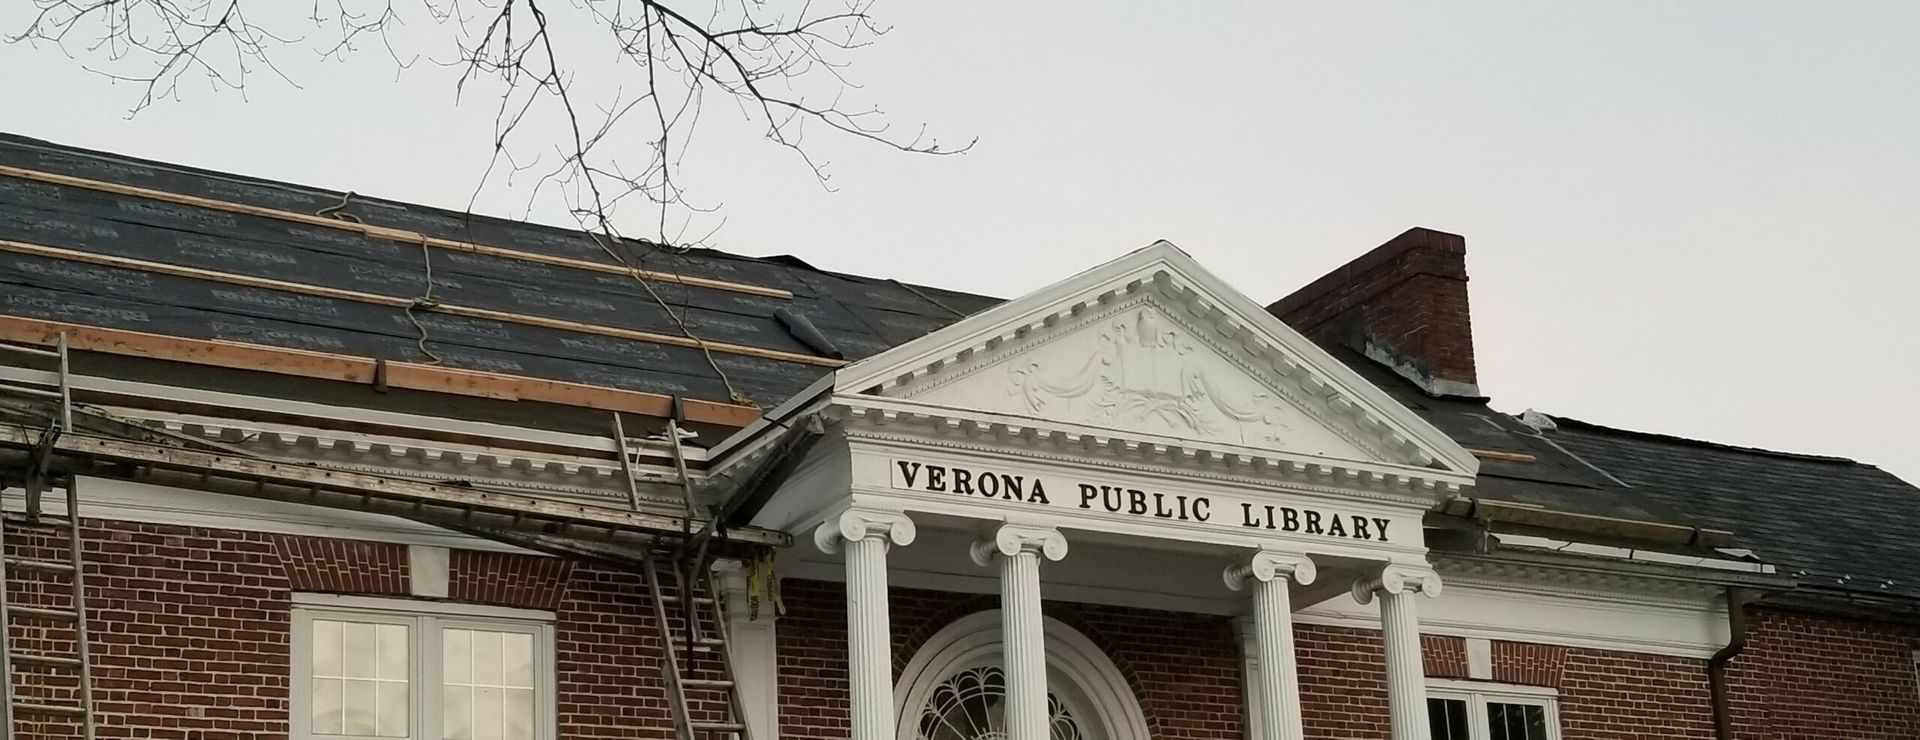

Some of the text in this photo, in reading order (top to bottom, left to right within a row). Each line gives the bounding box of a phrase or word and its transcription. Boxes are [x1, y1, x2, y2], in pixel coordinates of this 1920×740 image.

[898, 460, 1392, 542] VERONA PUBLIC LIBRARY
